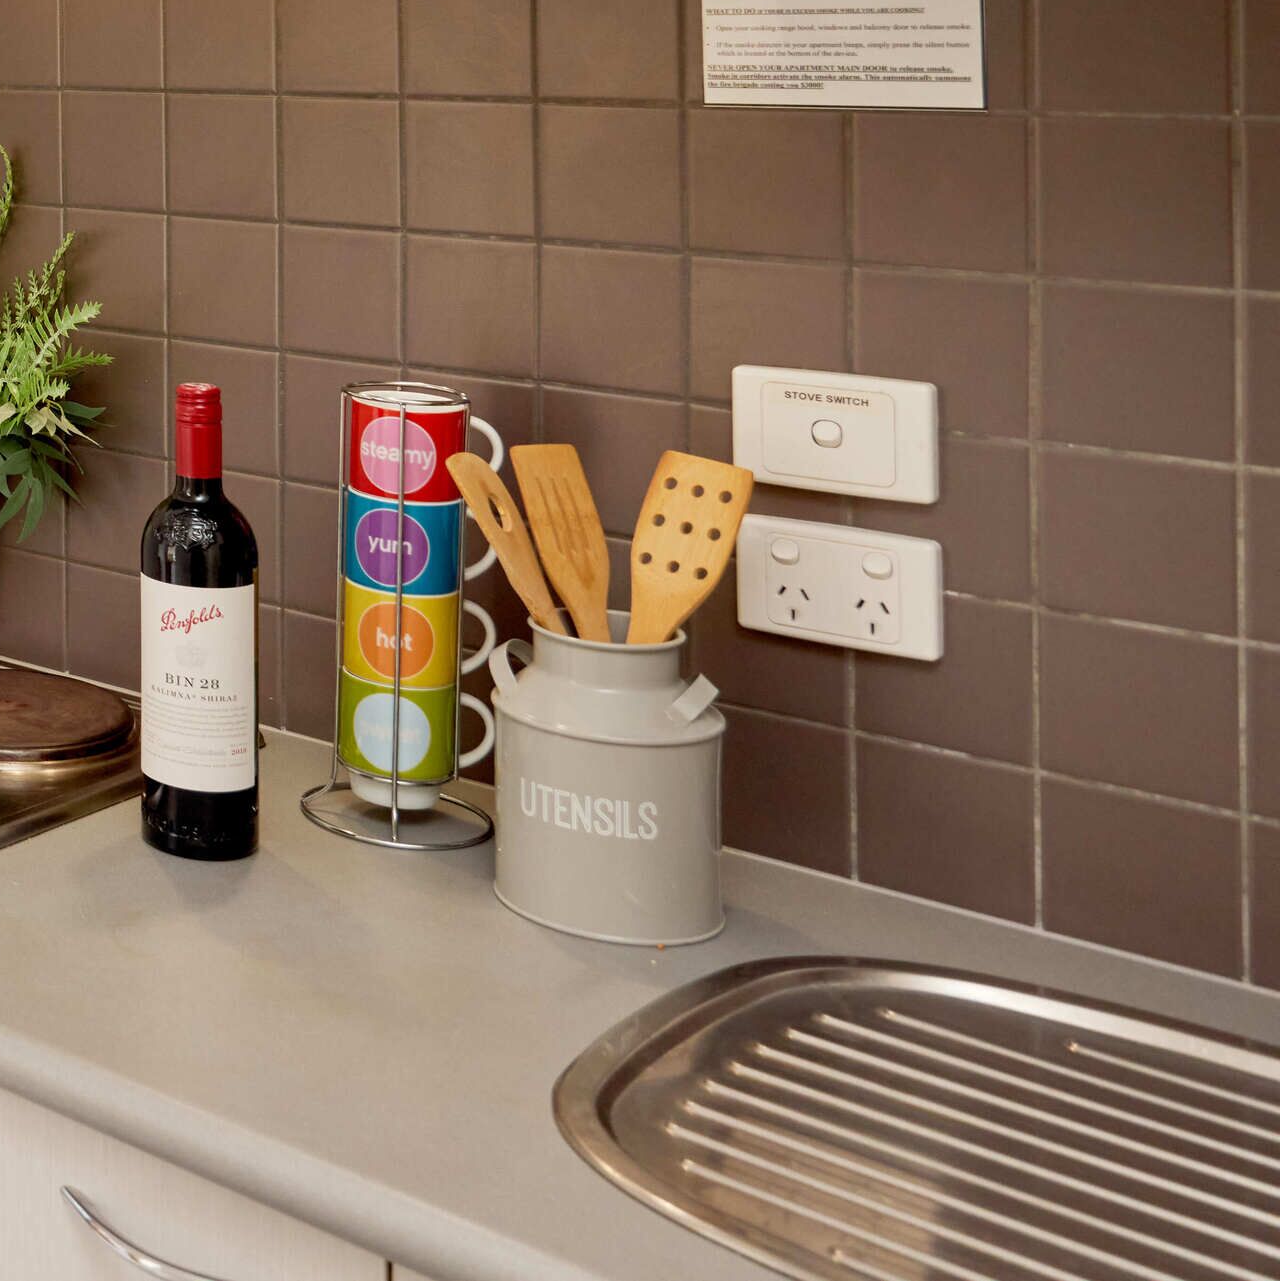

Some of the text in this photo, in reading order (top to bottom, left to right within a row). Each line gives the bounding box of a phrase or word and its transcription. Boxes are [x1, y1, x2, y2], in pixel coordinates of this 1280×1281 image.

[784, 390, 870, 407] STOVE SWITCH
[360, 440, 434, 470] steamy
[368, 535, 413, 556] yum
[160, 604, 224, 634] Penfolds
[375, 626, 413, 652] hot
[165, 672, 220, 689] BIN 28
[200, 694, 239, 702] SHIRAZ
[520, 776, 658, 840] UTENSILS
